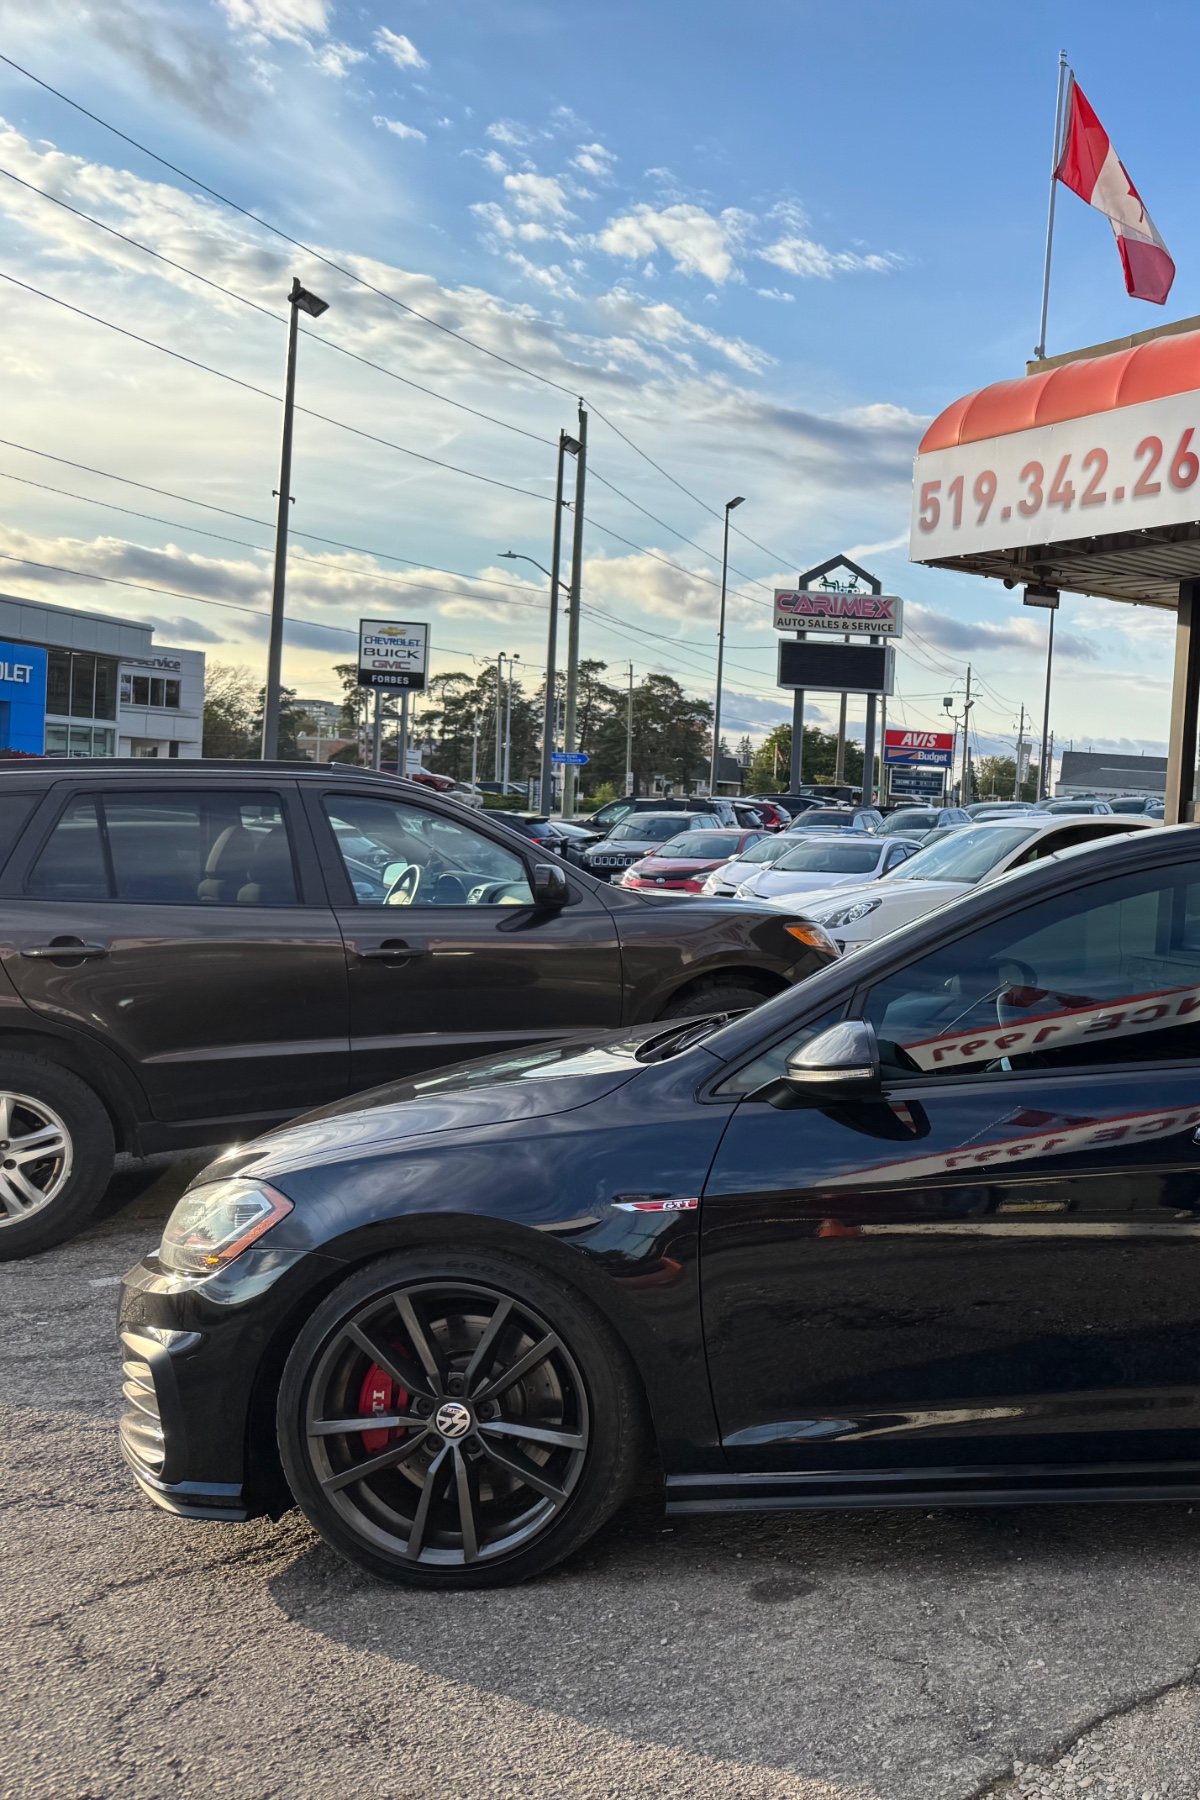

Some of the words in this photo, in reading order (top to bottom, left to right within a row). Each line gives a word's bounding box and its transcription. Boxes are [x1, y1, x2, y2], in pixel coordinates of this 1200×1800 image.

[776, 593, 896, 618] CARIMEX
[776, 617, 805, 628] AUTO
[808, 619, 839, 629] SALES
[841, 621, 849, 630] &
[851, 622, 894, 632] SERVICE
[364, 636, 421, 647] CHEVROLET
[363, 647, 420, 659] BUICK
[372, 659, 411, 670] GMC
[371, 674, 410, 685] FORBES
[900, 732, 938, 748] AVIS
[918, 750, 948, 763] Budget
[663, 1200, 691, 1210] GTI
